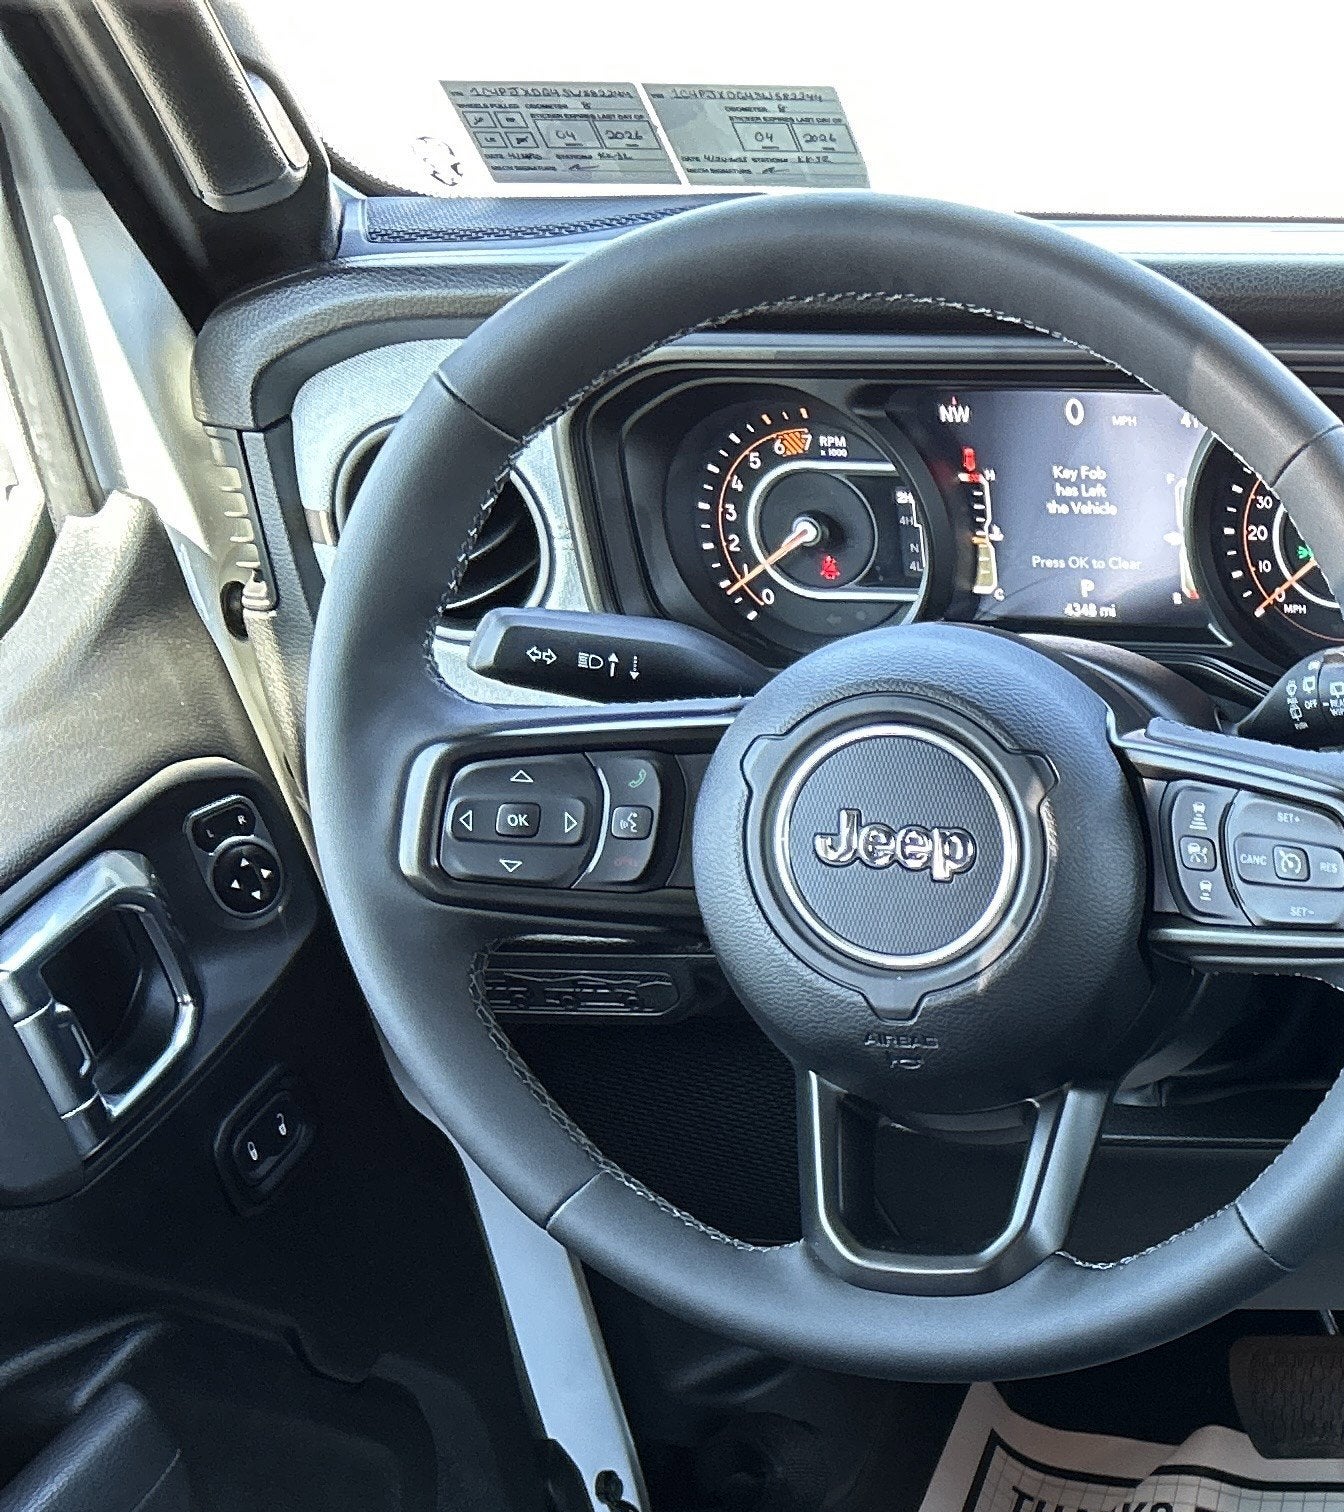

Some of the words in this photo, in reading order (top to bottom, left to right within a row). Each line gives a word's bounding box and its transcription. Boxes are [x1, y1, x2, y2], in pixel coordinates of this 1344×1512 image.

[605, 130, 643, 140] 2026
[755, 131, 774, 142] 04
[803, 133, 836, 143] 2026
[939, 404, 970, 423] NW
[1065, 398, 1085, 426] 0
[1112, 415, 1137, 427] MPH
[774, 440, 786, 455] 6
[801, 433, 813, 450] 7
[819, 435, 847, 447] RPM
[829, 449, 848, 457] 1000
[748, 452, 762, 470] 5
[1052, 465, 1078, 482] Key
[1080, 466, 1107, 480] Fob
[1166, 473, 1175, 484] F
[731, 476, 744, 492] 4
[1055, 484, 1079, 497] has
[1081, 484, 1107, 498] Left
[1046, 501, 1069, 515] the
[1070, 501, 1117, 516] Vehicle
[1256, 496, 1273, 509] 30
[725, 505, 738, 521] 3
[900, 516, 913, 525] 4H
[1247, 525, 1268, 541] 20
[728, 535, 741, 552] 2
[910, 543, 919, 553] N
[910, 561, 923, 571] 4L
[1032, 555, 1066, 570] Press
[1068, 556, 1090, 569] OK
[1092, 558, 1106, 569] to
[1108, 557, 1143, 570] Clear
[1258, 560, 1271, 573] 10
[994, 588, 1005, 600] C
[1081, 579, 1095, 598] P
[761, 589, 775, 605] 0
[1099, 604, 1116, 618] mi
[1284, 604, 1307, 615] MPH
[1304, 699, 1318, 709] OFF
[237, 815, 247, 825] R
[507, 815, 529, 827] OK
[206, 830, 215, 838] L
[814, 807, 977, 882] Jeep
[1241, 854, 1267, 866] CANC
[1320, 862, 1338, 873] RES
[865, 1033, 939, 1049] AIRBAG
